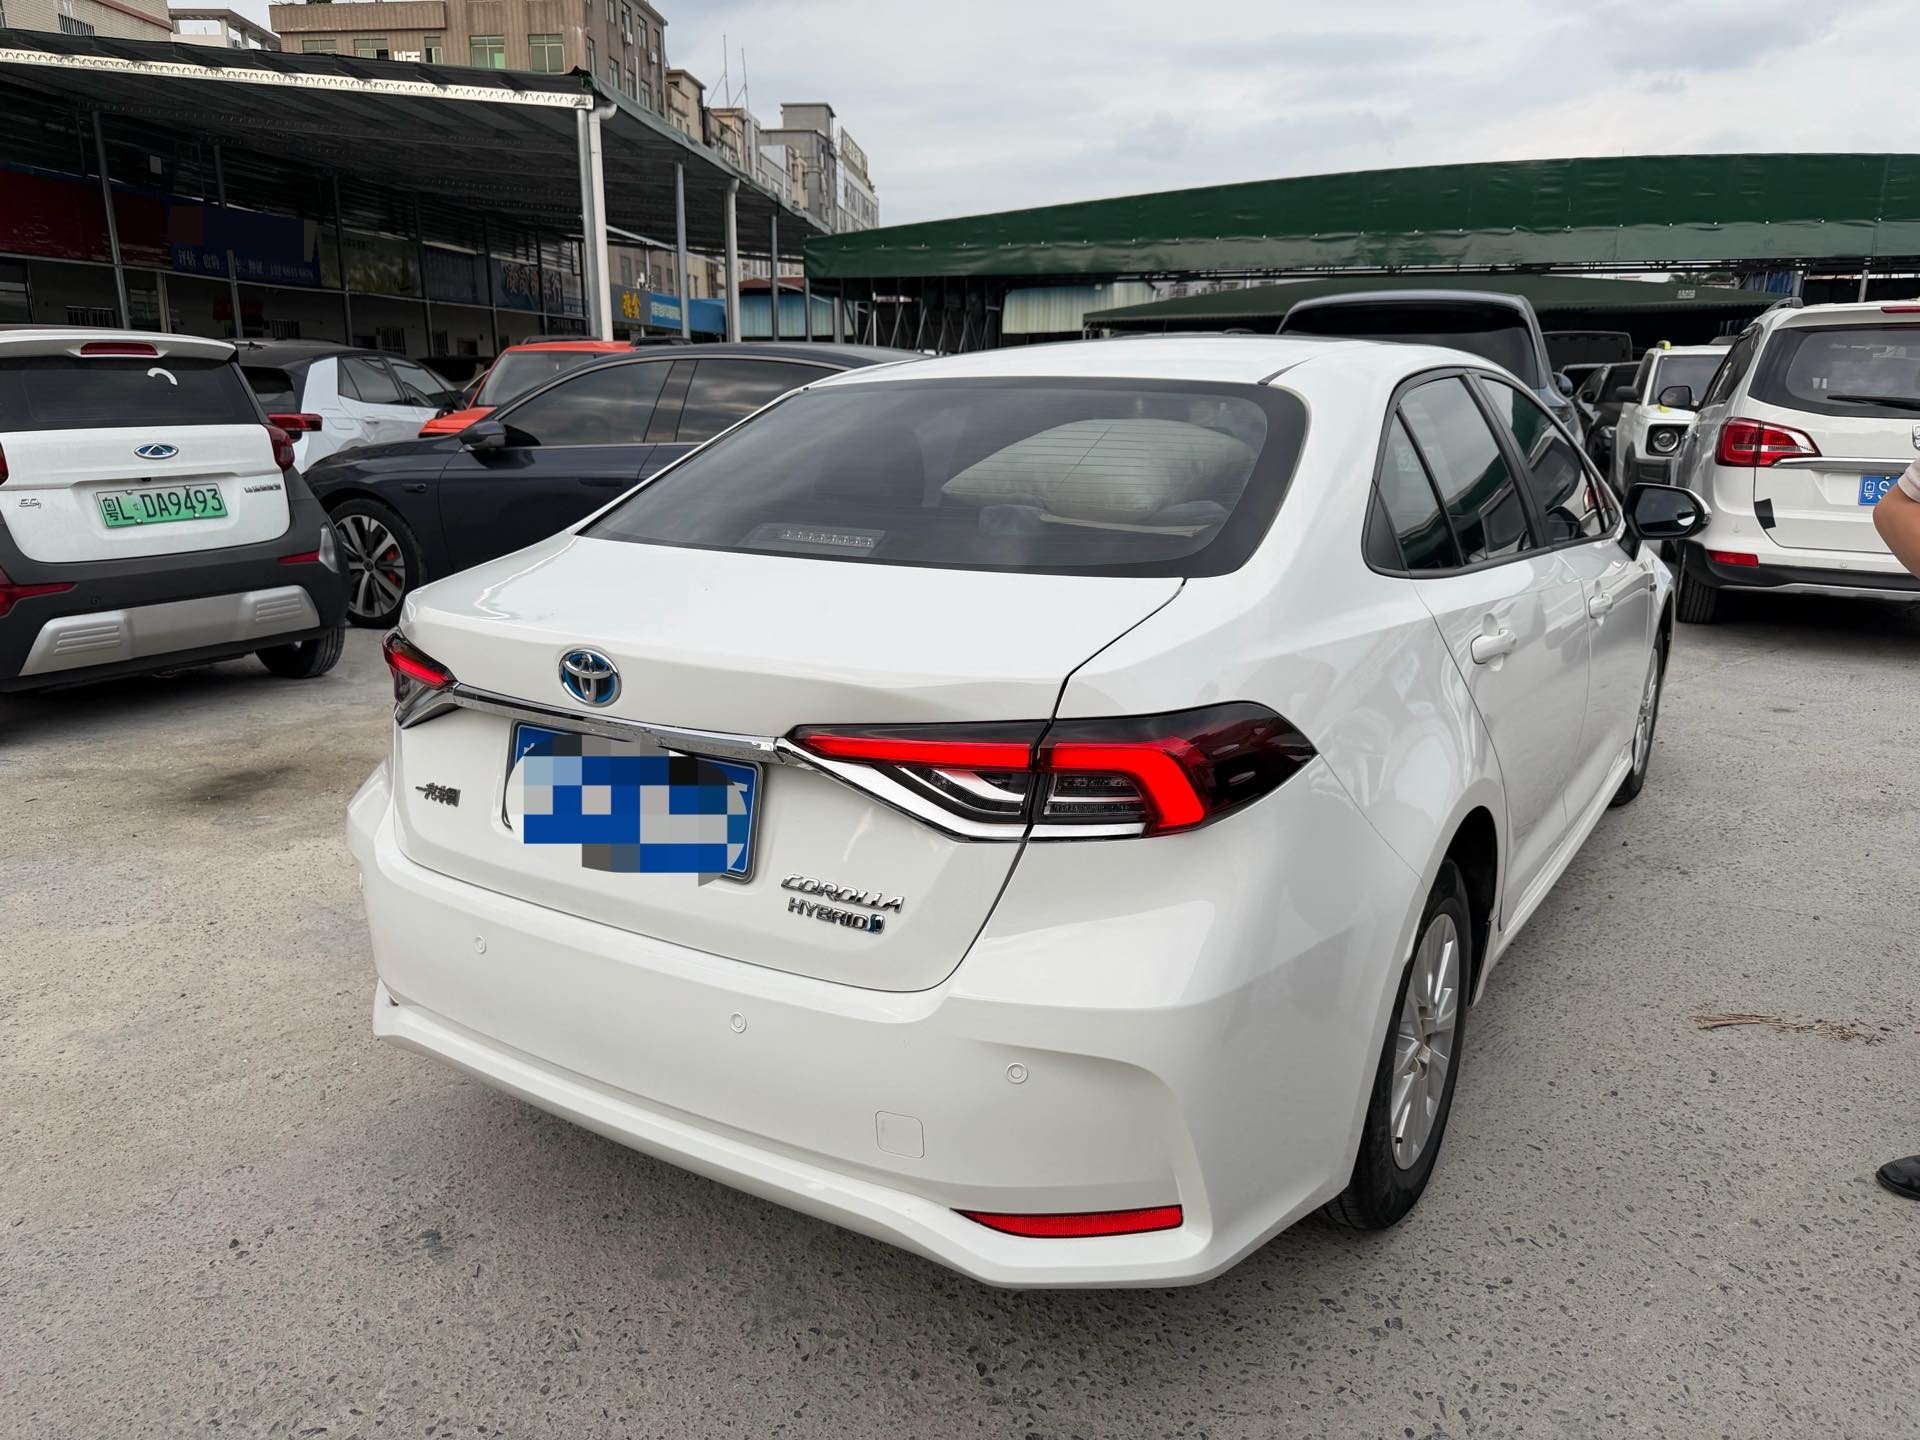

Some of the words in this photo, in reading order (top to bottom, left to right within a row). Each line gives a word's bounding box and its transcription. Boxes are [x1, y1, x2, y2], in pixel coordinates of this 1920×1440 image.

[104, 496, 134, 521] 粤L
[140, 488, 223, 518] DA9493
[781, 874, 904, 914] COROLLA
[788, 897, 869, 931] HYBRID
